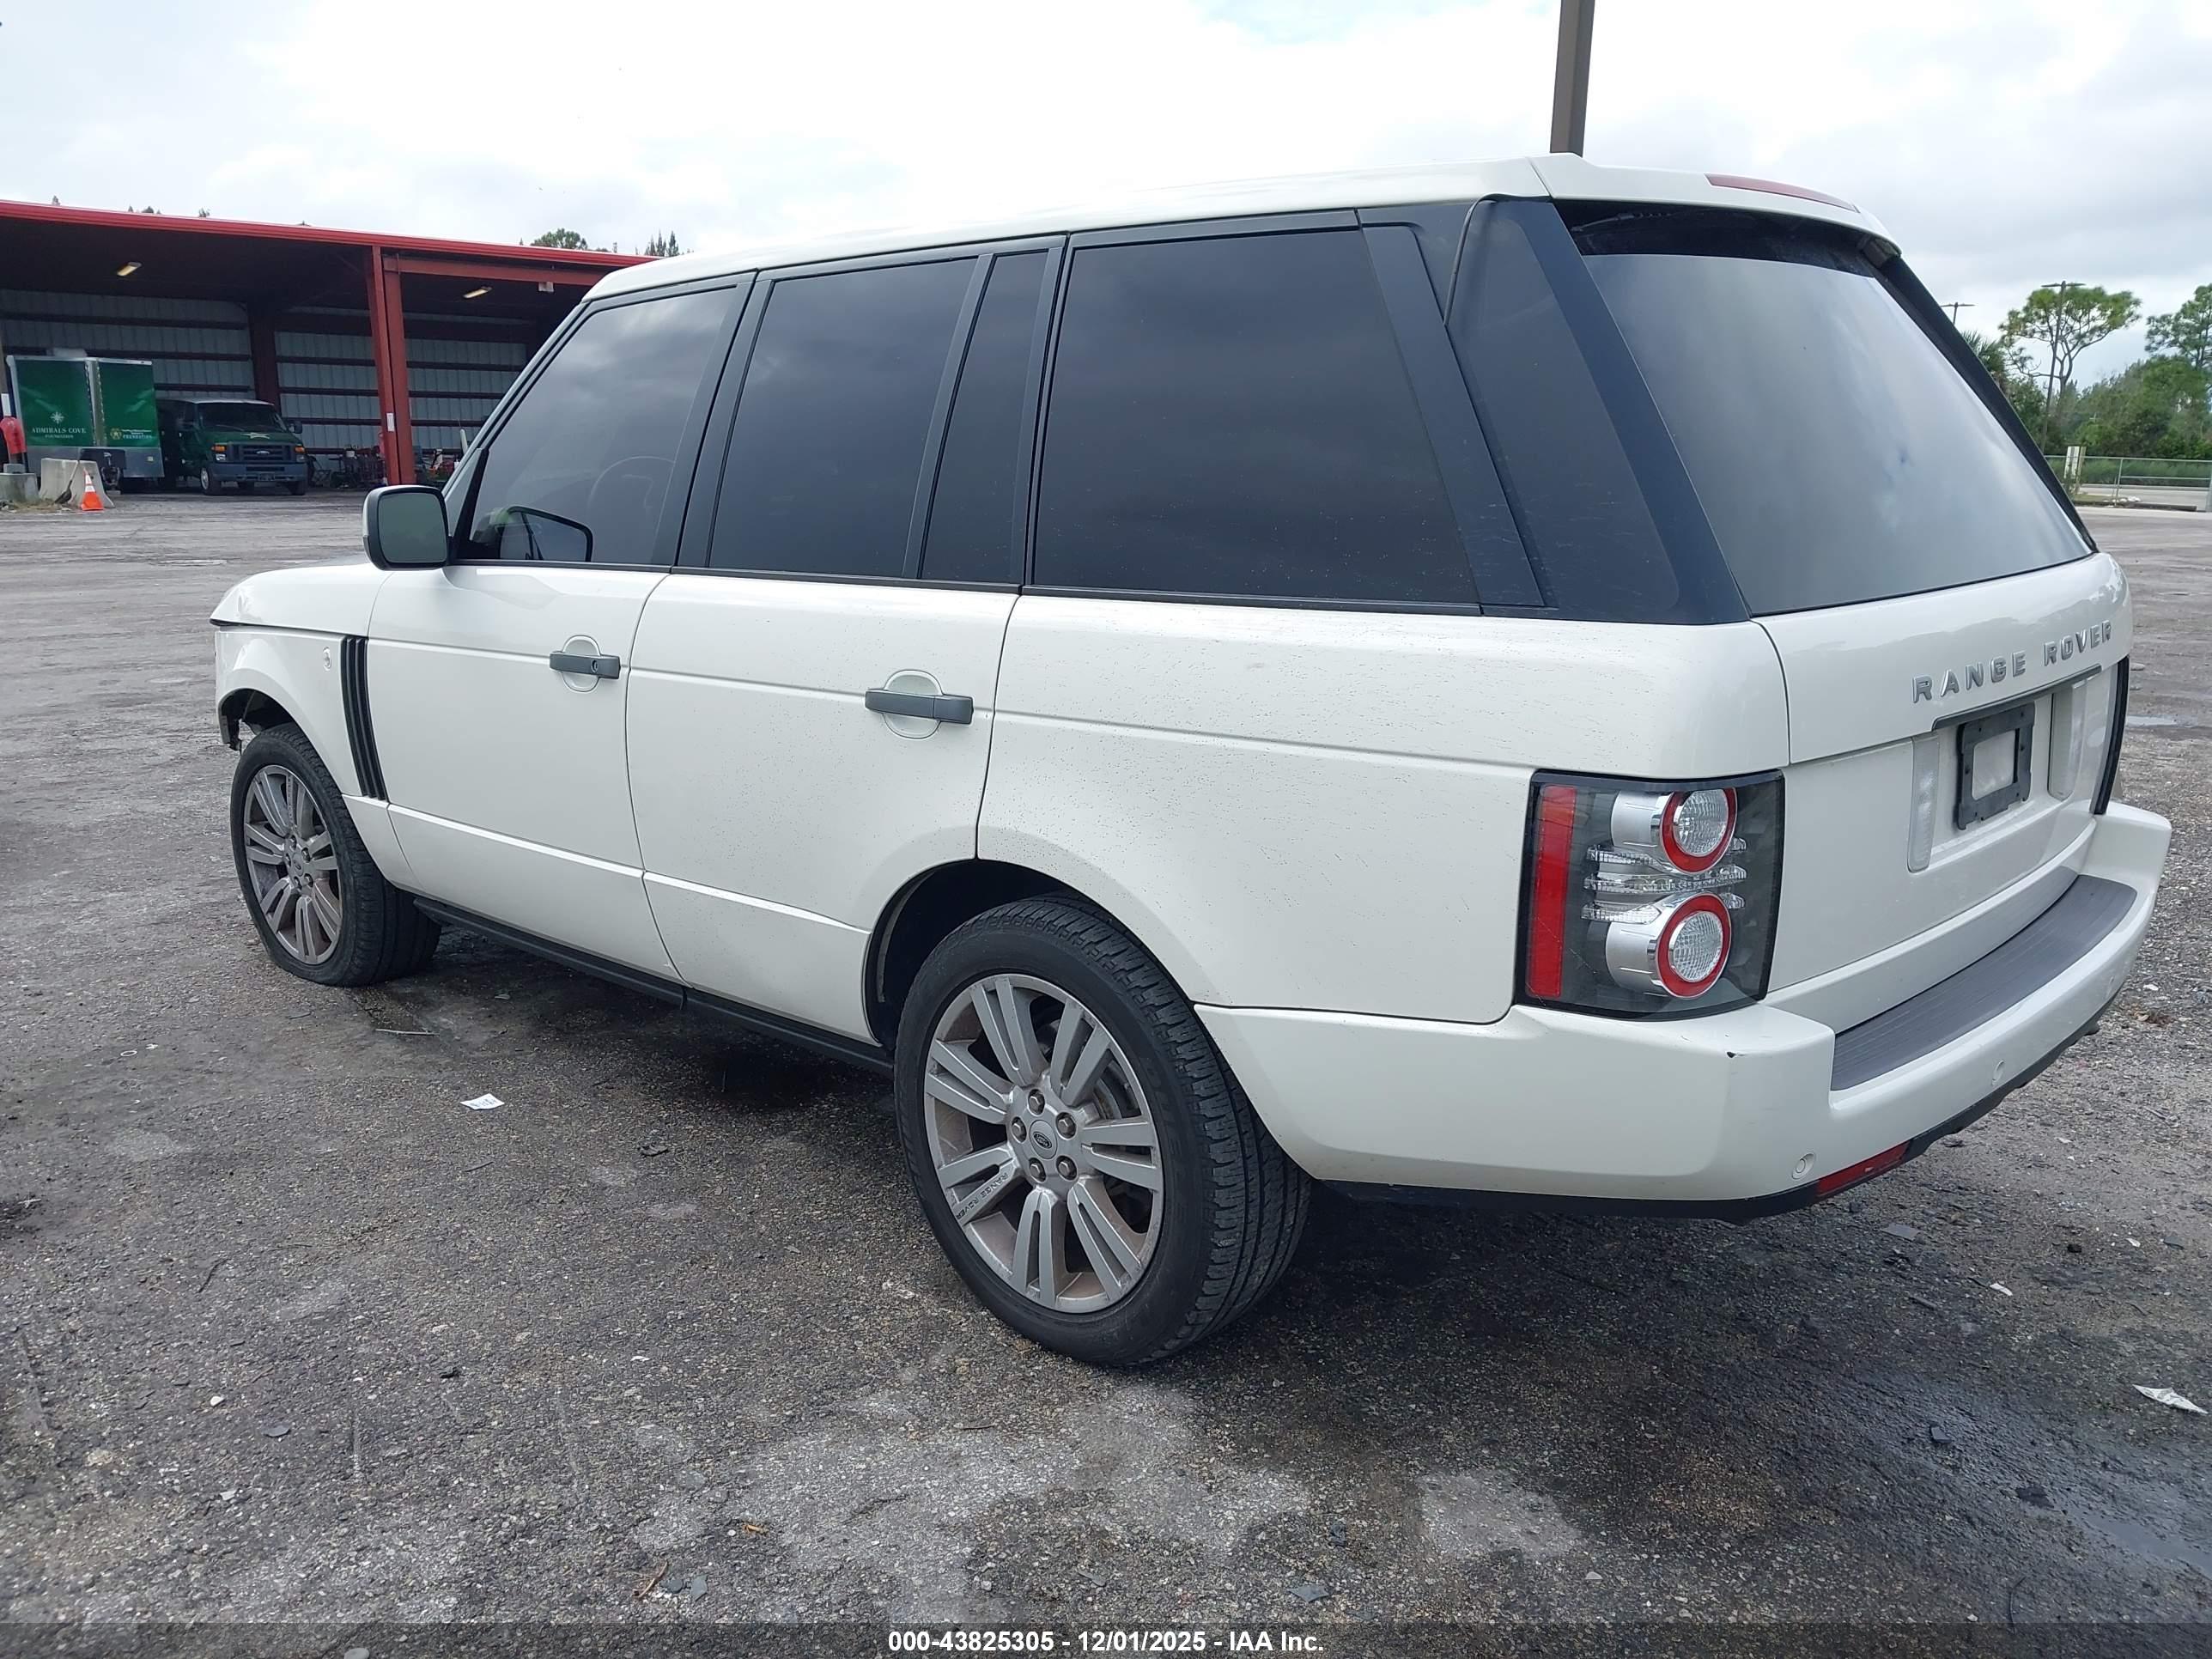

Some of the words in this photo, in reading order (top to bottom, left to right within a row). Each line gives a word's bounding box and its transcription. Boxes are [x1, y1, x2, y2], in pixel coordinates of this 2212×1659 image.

[1912, 651, 2027, 703] RANGE
[2043, 620, 2112, 666] ROVER
[981, 1172, 1008, 1198] RANGE
[956, 1197, 978, 1219] ROVER
